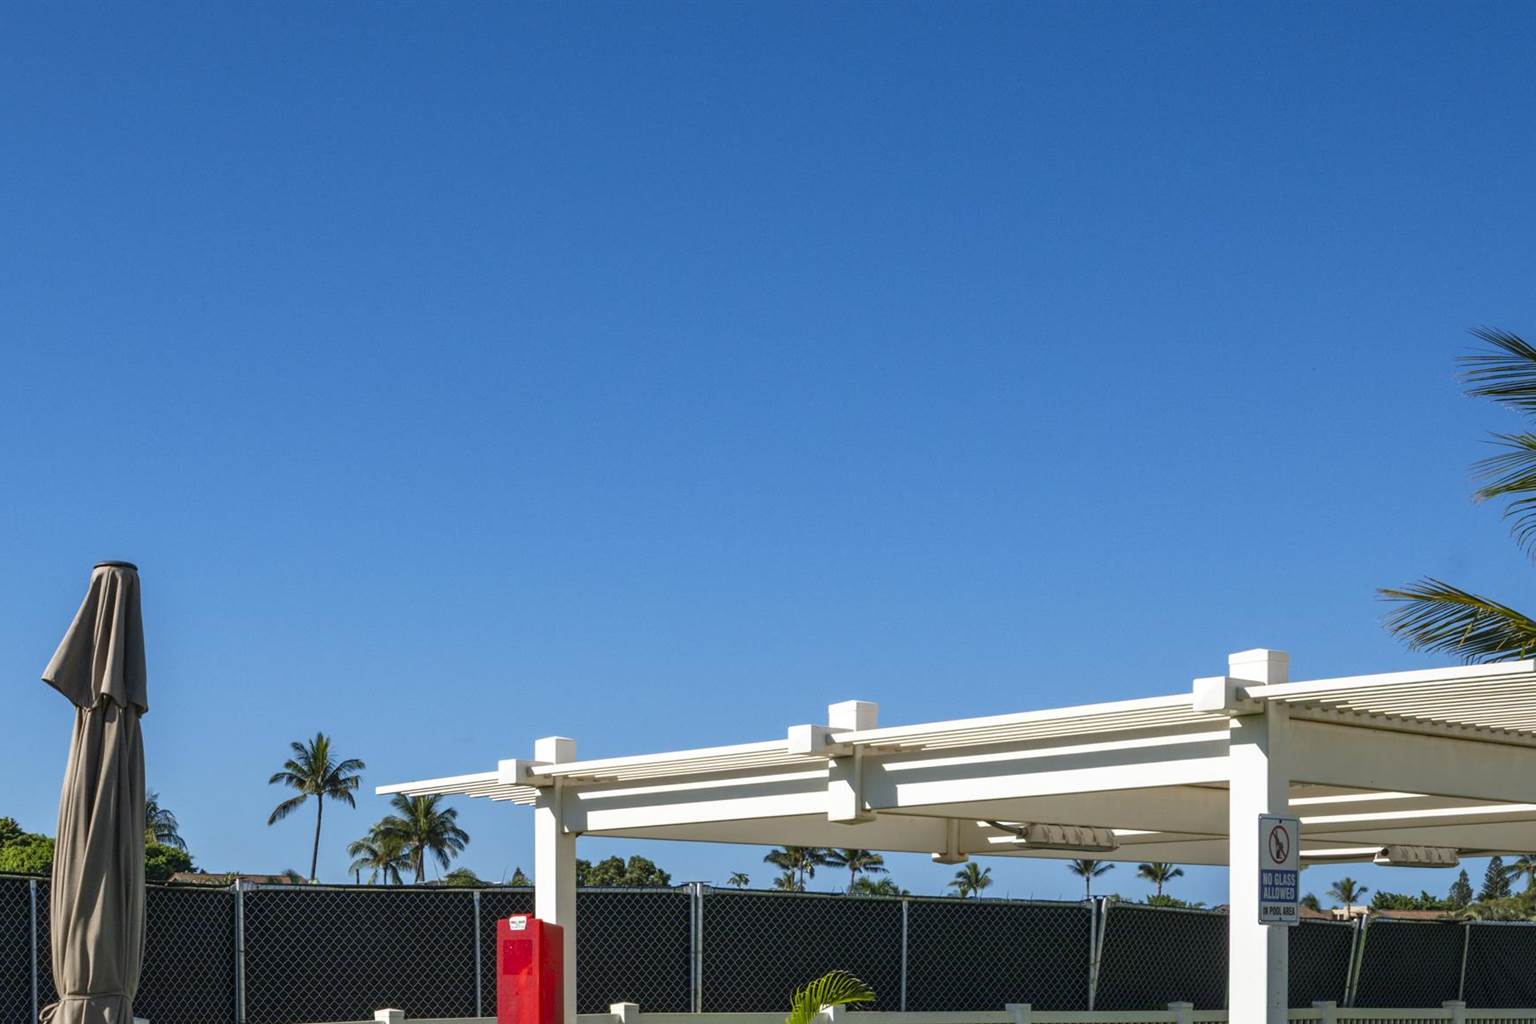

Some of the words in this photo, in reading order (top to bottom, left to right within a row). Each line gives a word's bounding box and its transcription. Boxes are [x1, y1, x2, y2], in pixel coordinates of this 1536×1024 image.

[1263, 872, 1272, 885] NO
[1274, 872, 1295, 886] GLASS
[1263, 887, 1294, 900] ALLOWED
[1263, 906, 1268, 915] IN
[1269, 906, 1281, 915] POOL
[1283, 906, 1295, 915] AREA
